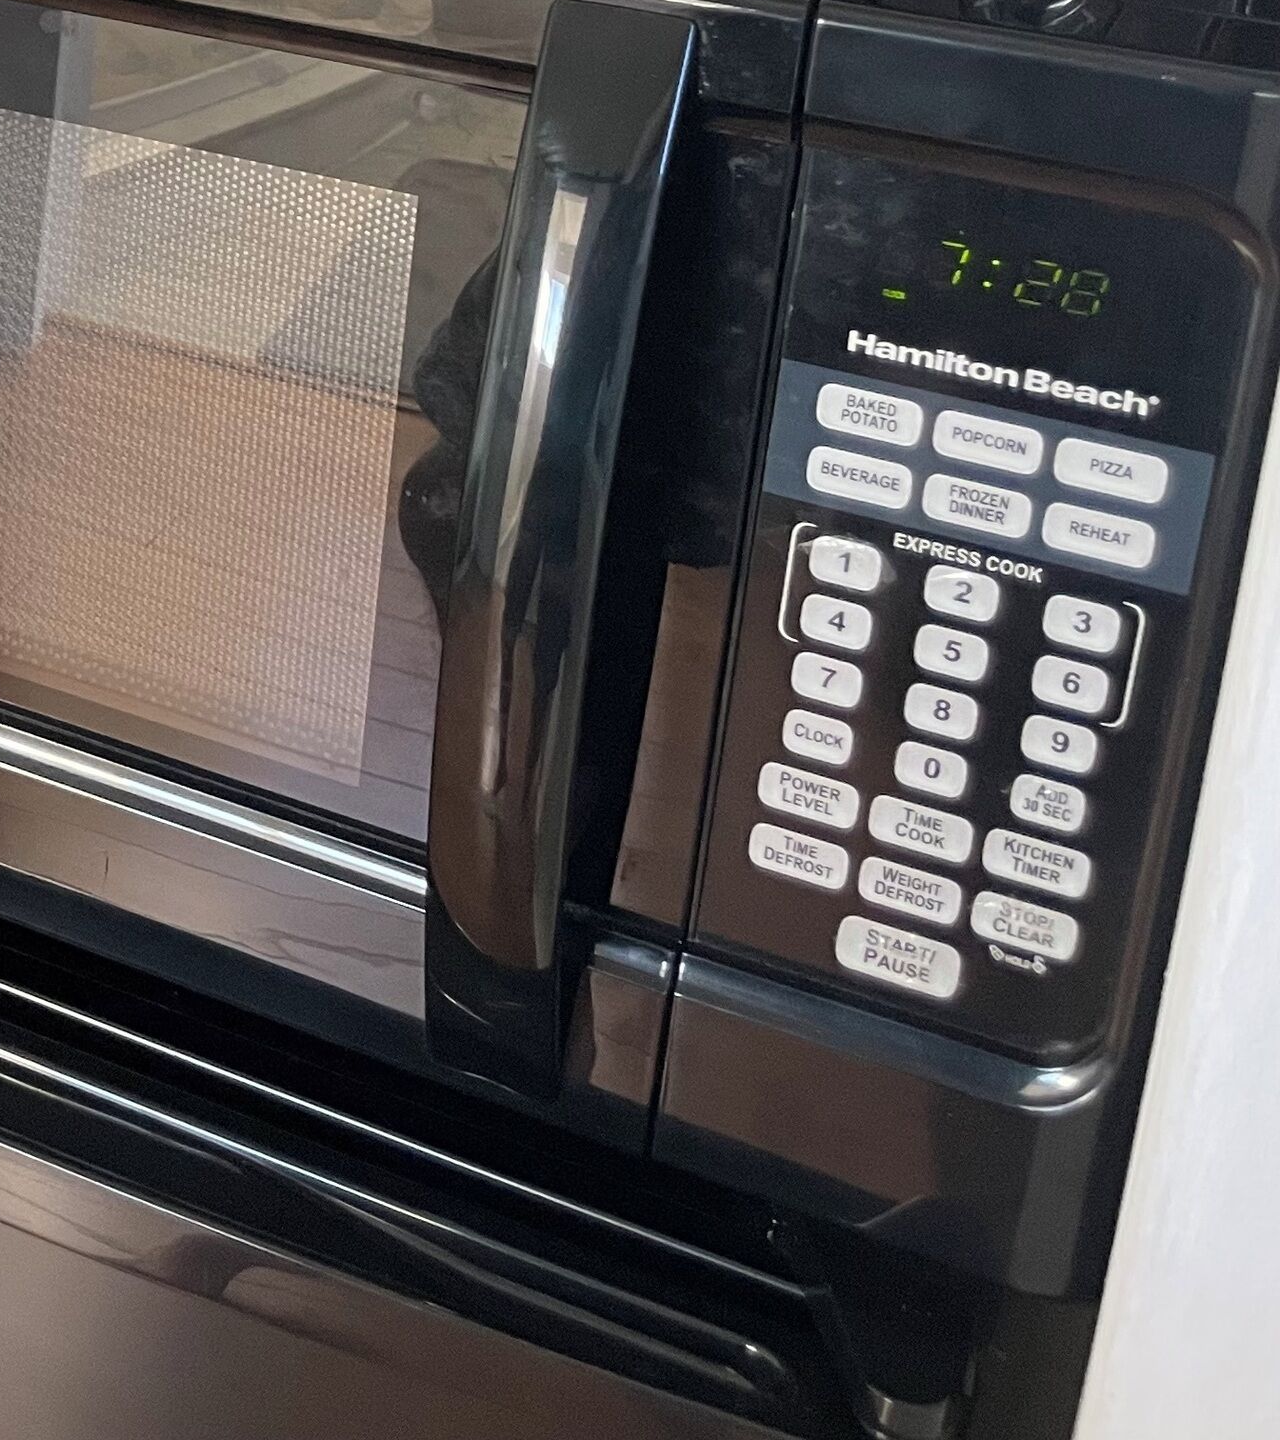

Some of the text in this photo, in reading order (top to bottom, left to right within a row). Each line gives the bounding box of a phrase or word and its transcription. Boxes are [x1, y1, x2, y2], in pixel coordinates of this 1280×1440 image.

[942, 239, 1110, 316] 7:28
[845, 329, 1153, 418] Hamilton Beach
[845, 393, 897, 419] BAKED
[840, 408, 899, 435] POTATO
[951, 426, 1028, 458] POPCORN
[821, 460, 901, 493] BEVERAGE
[1089, 458, 1134, 482] PIZZA
[948, 484, 1010, 511] FROZEN
[948, 500, 1006, 526] DINNER
[1069, 520, 1132, 548] REHEAT
[838, 551, 853, 573] 1
[892, 532, 1044, 584] EXPRESS COOK
[951, 581, 974, 605] 2
[826, 610, 847, 634] 4
[1072, 610, 1093, 635] 3
[942, 640, 963, 663] 5
[820, 667, 839, 689] 7
[1062, 671, 1082, 696] 6
[932, 699, 952, 722] 8
[793, 722, 845, 751] CLOCK
[1050, 730, 1071, 754] 9
[923, 757, 942, 781] 0
[779, 770, 842, 802] POWER
[1035, 784, 1069, 805] ADD
[781, 789, 834, 818] LEVEL
[1022, 797, 1073, 822] 30 SEC
[903, 807, 944, 833] TIME
[782, 834, 819, 860] TIME
[894, 822, 946, 851] COOK
[763, 846, 835, 880] DEFROST
[1003, 836, 1075, 872] KITCHEN
[881, 865, 943, 898] WEIGHT
[1012, 858, 1062, 885] TIMER
[873, 880, 946, 915] DEFROST
[992, 917, 1054, 948] CLEAR
[865, 927, 938, 966] START/
[863, 949, 932, 985] PAUSE
